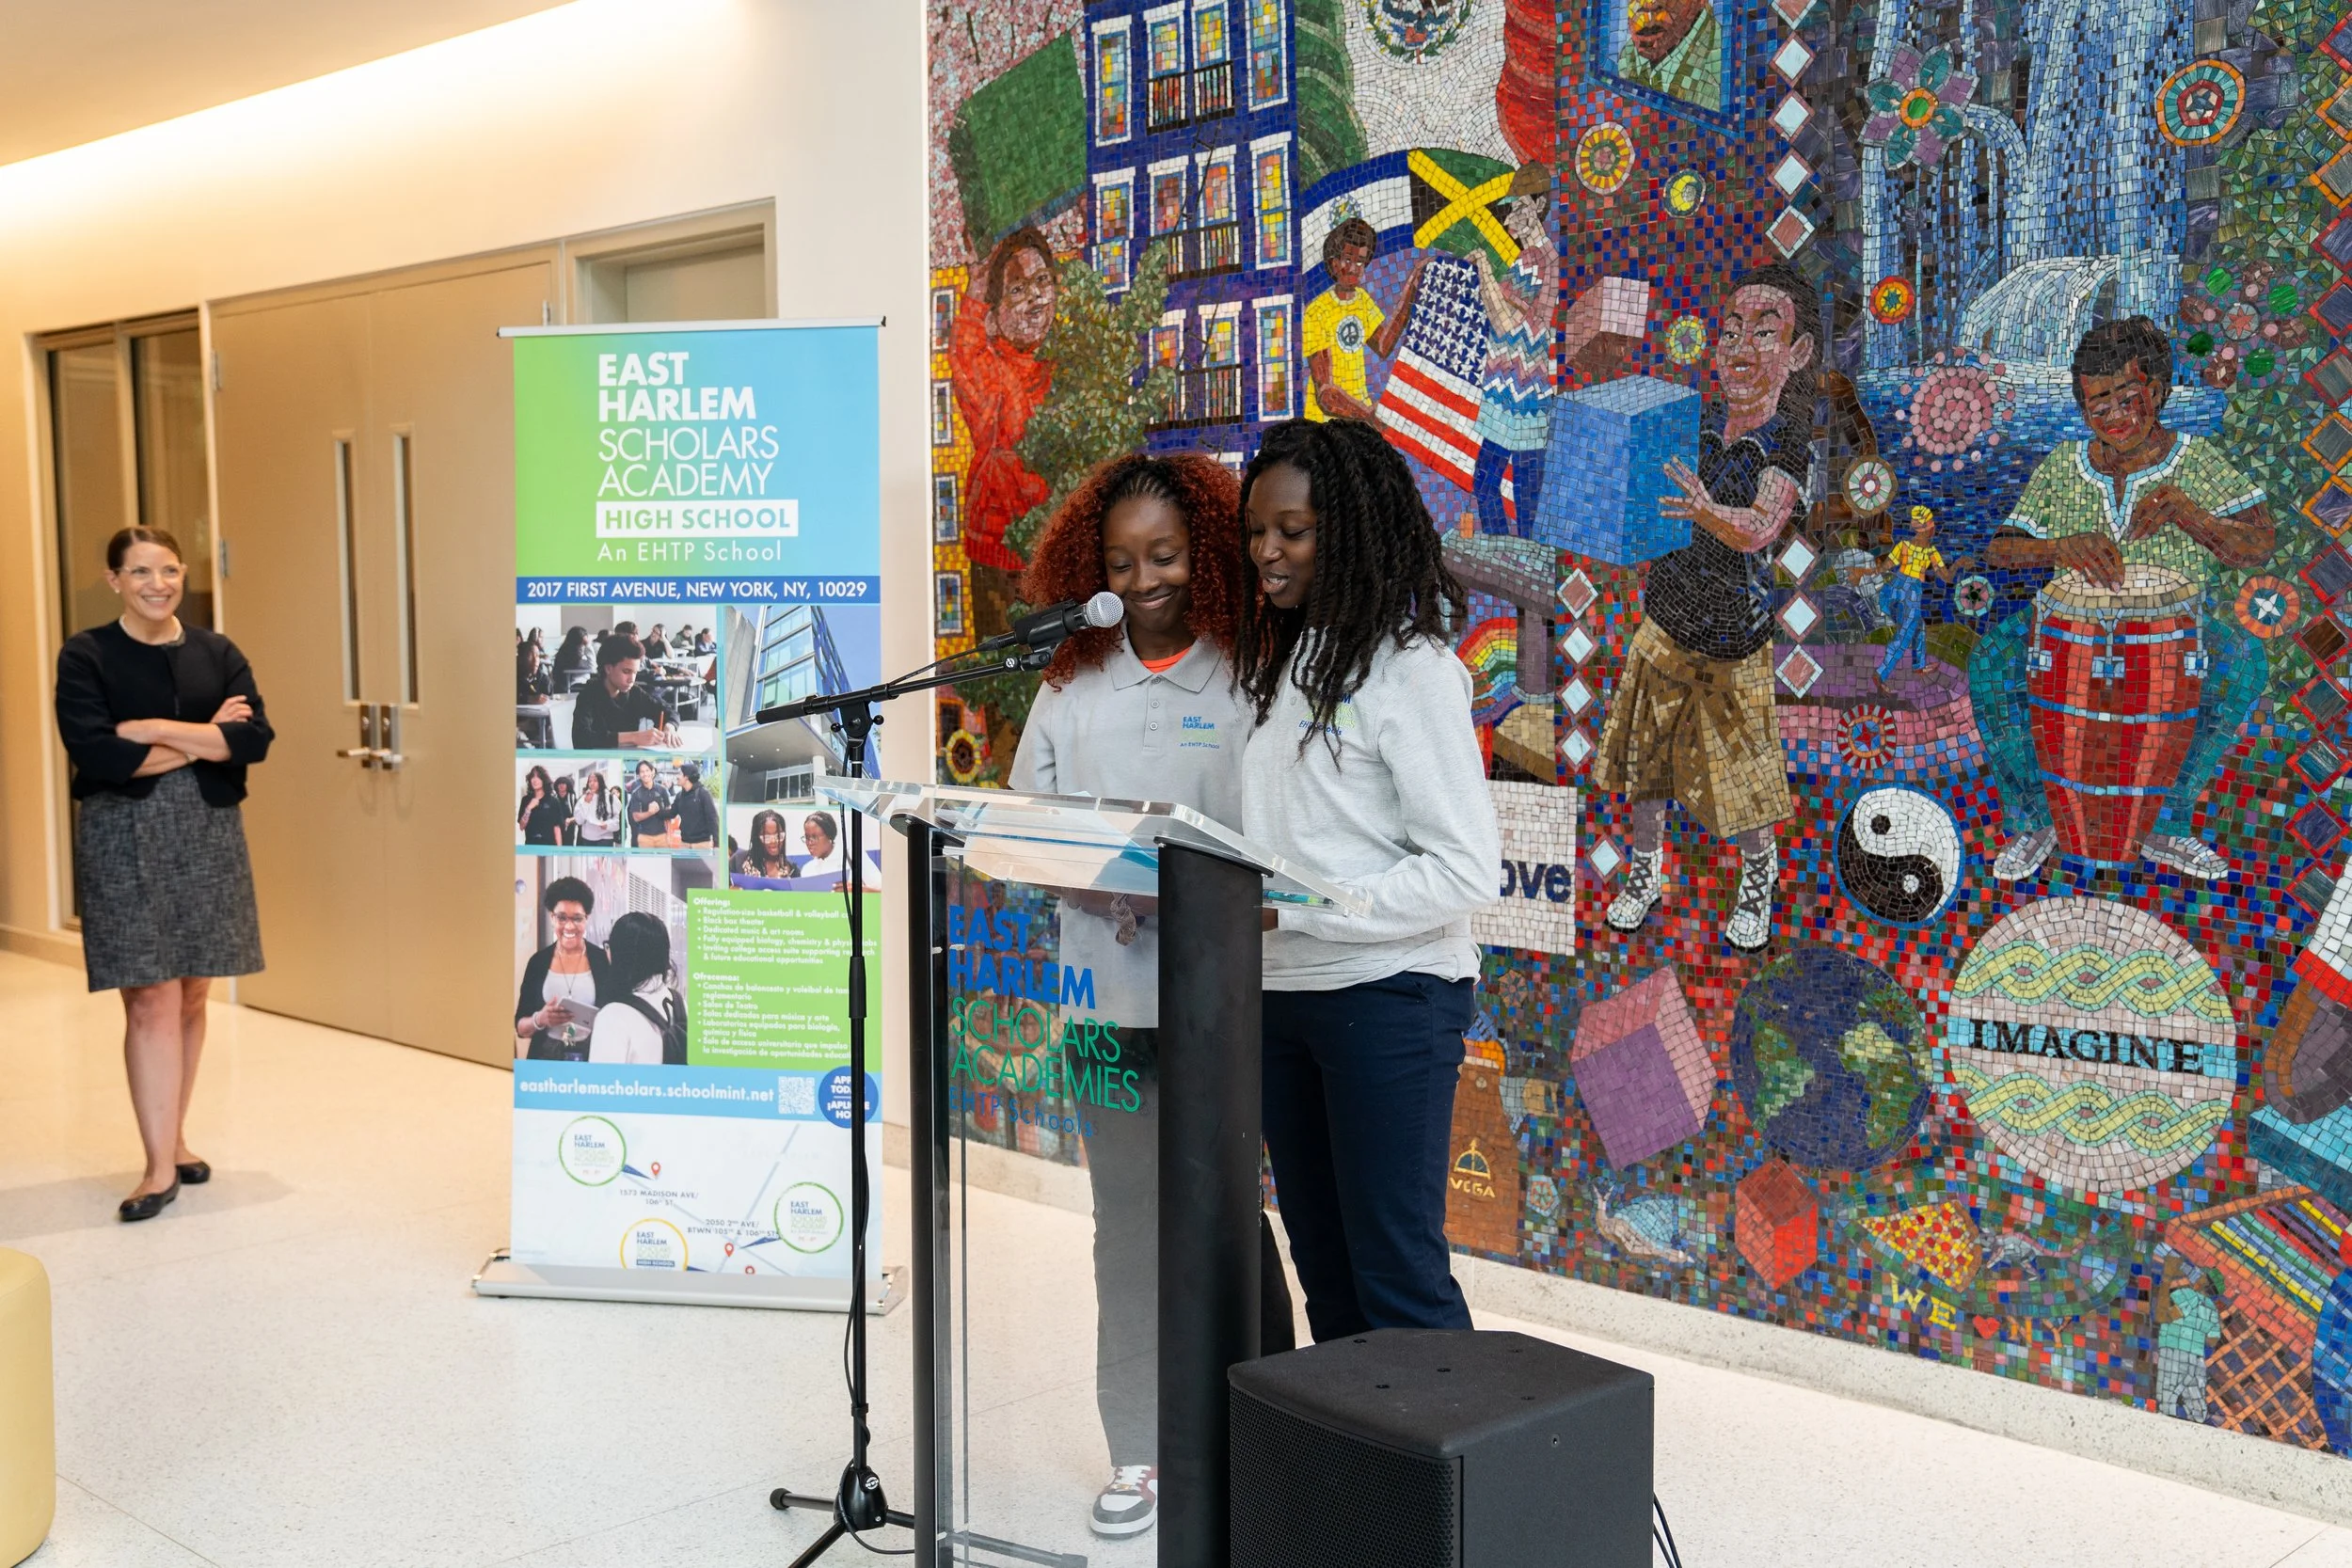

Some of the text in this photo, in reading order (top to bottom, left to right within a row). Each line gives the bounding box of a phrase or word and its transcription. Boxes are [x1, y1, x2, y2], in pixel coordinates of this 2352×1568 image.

[598, 352, 689, 387] EAST
[598, 387, 756, 422] HARLEM
[598, 425, 780, 462] SCHOLARS
[597, 462, 773, 497] ACADEMY
[605, 507, 790, 530] HIGH SCHOOL
[597, 540, 782, 562] An EHTP School
[527, 581, 867, 600] 2017 FIRST AVENUE, NEW YORK, NY, 10029
[1501, 859, 1571, 903] ove
[703, 916, 722, 925] Black
[739, 918, 765, 927] theater
[757, 908, 794, 918] basketball
[803, 910, 839, 920] volleyball
[703, 925, 739, 934] Dedicated
[740, 927, 760, 935] music
[949, 905, 1032, 954] EAST
[703, 934, 720, 943] Fully
[722, 935, 755, 944] equipped
[756, 936, 786, 946] biology,
[787, 938, 821, 947] chemistry
[703, 942, 729, 954] Inviting
[730, 943, 756, 955] college
[784, 946, 800, 955] suite
[802, 947, 841, 958] supporting
[711, 953, 731, 961] future
[733, 954, 774, 963] educational
[776, 956, 824, 965] opportunities
[703, 982, 733, 990] Canchas
[735, 983, 744, 991] de
[745, 983, 785, 992] baloncesto
[823, 986, 834, 994] de
[949, 948, 1096, 1009] HARLEM
[703, 991, 753, 1001] reglamentario
[724, 1001, 734, 1009] de
[736, 1002, 758, 1010] Teatro
[703, 1019, 747, 1028] Laboratorios
[749, 1021, 787, 1030] equipados
[788, 1022, 805, 1031] para
[723, 1010, 760, 1019] dedicadas
[762, 1013, 780, 1022] para
[951, 997, 1121, 1063] SCHOLARS
[703, 1046, 710, 1054] la
[758, 1048, 769, 1056] de
[770, 1049, 822, 1059] oportunidades
[721, 1037, 730, 1046] de
[757, 1038, 803, 1049] universitario
[804, 1041, 818, 1051] que
[819, 1040, 849, 1052] impulsa
[1969, 1019, 2202, 1074] IMAGINE
[951, 1041, 1140, 1113] ACADEMIES
[520, 1077, 774, 1102] eastharlemscholars.schoolmint.net
[949, 1086, 1094, 1138] EHTP Schools
[640, 1190, 678, 1198] MADISON
[1890, 1273, 2073, 1348] WE NY
